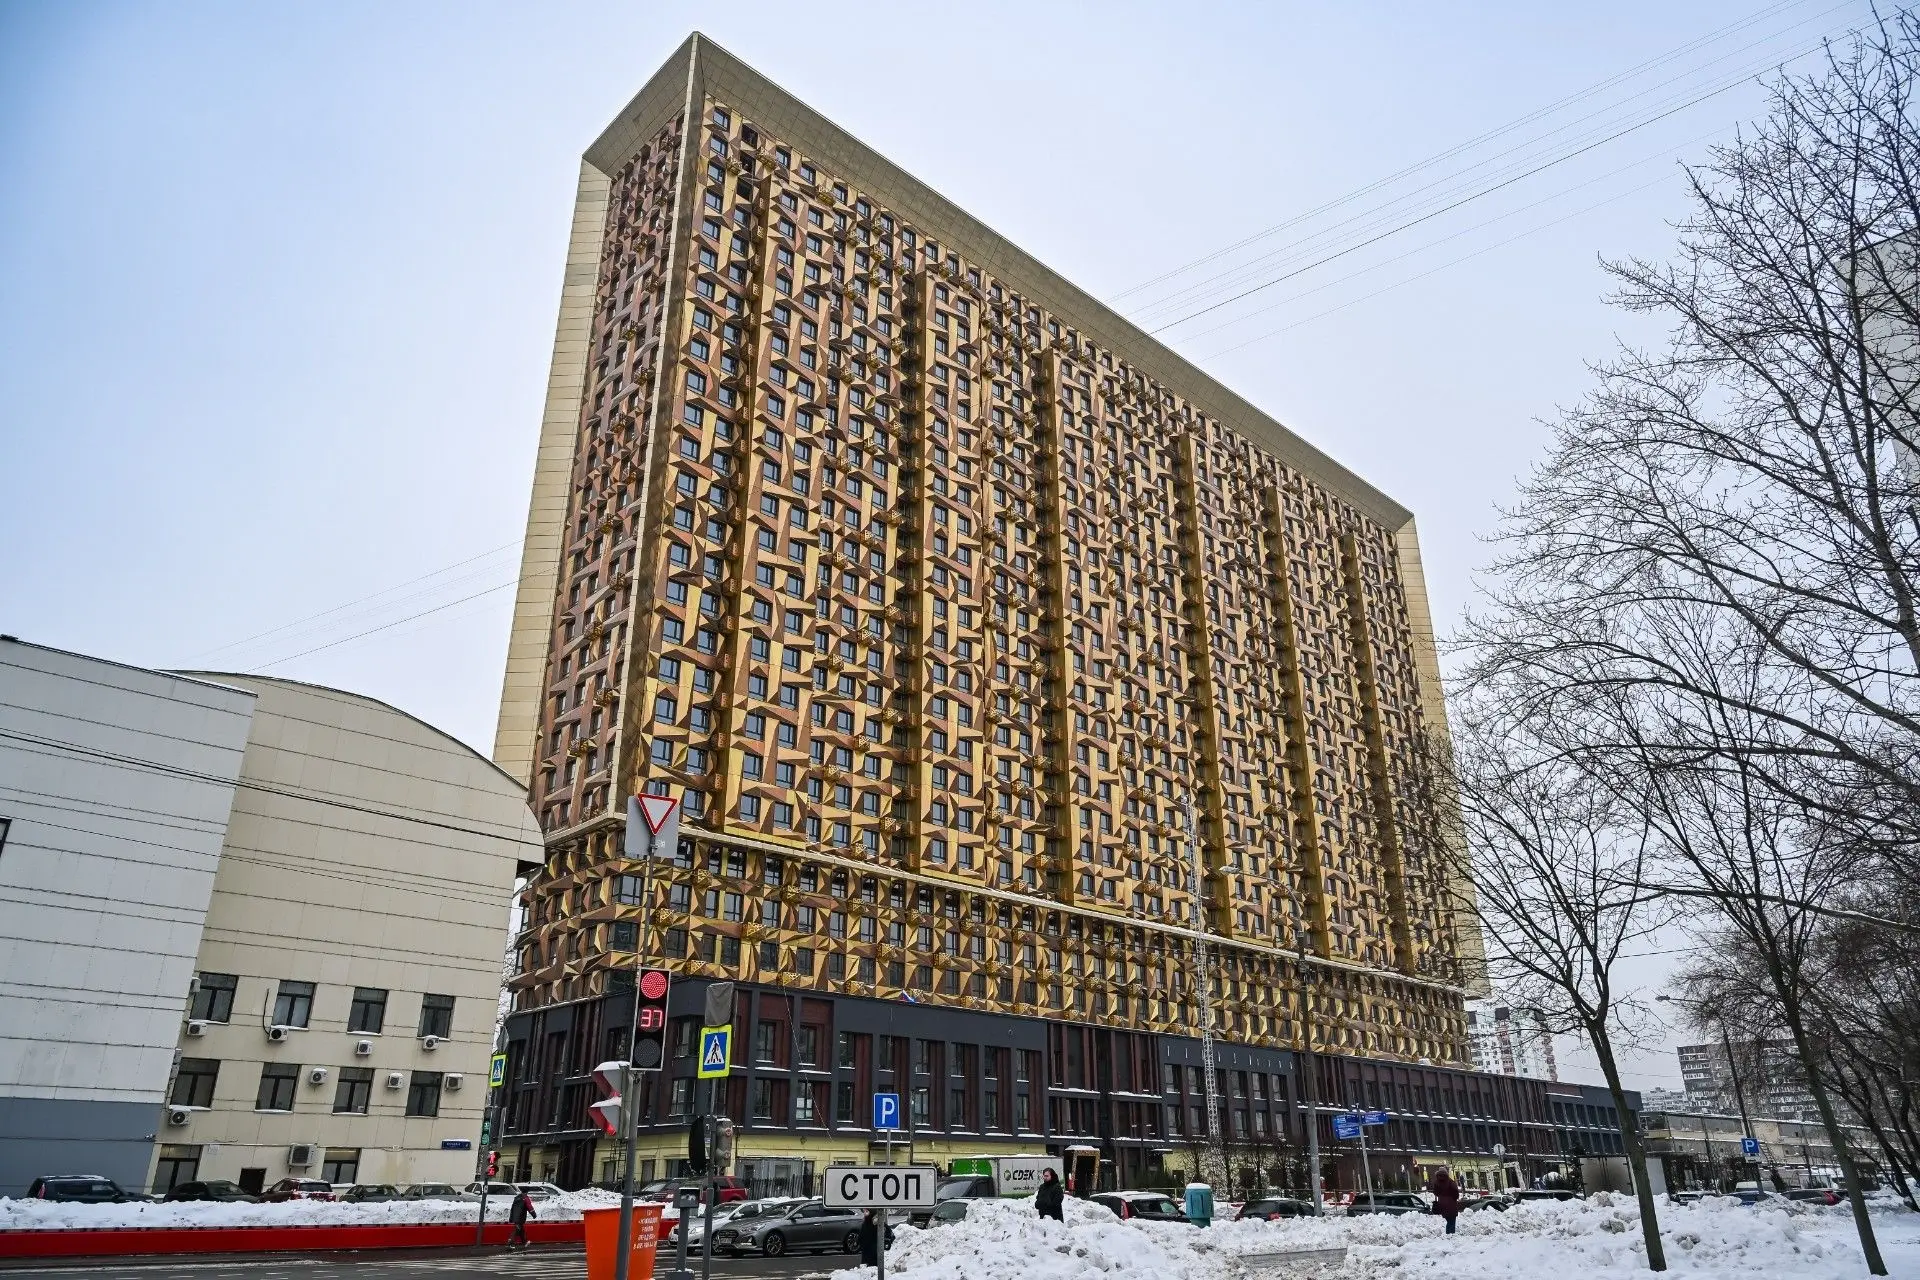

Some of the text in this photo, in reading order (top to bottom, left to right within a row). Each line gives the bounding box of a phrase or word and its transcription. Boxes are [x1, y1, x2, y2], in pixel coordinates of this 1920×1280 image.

[641, 1009, 663, 1028] 37
[881, 1097, 895, 1125] P
[1745, 1139, 1755, 1152] P
[1012, 1169, 1035, 1181] CDEK
[841, 1173, 921, 1201] СТОП
